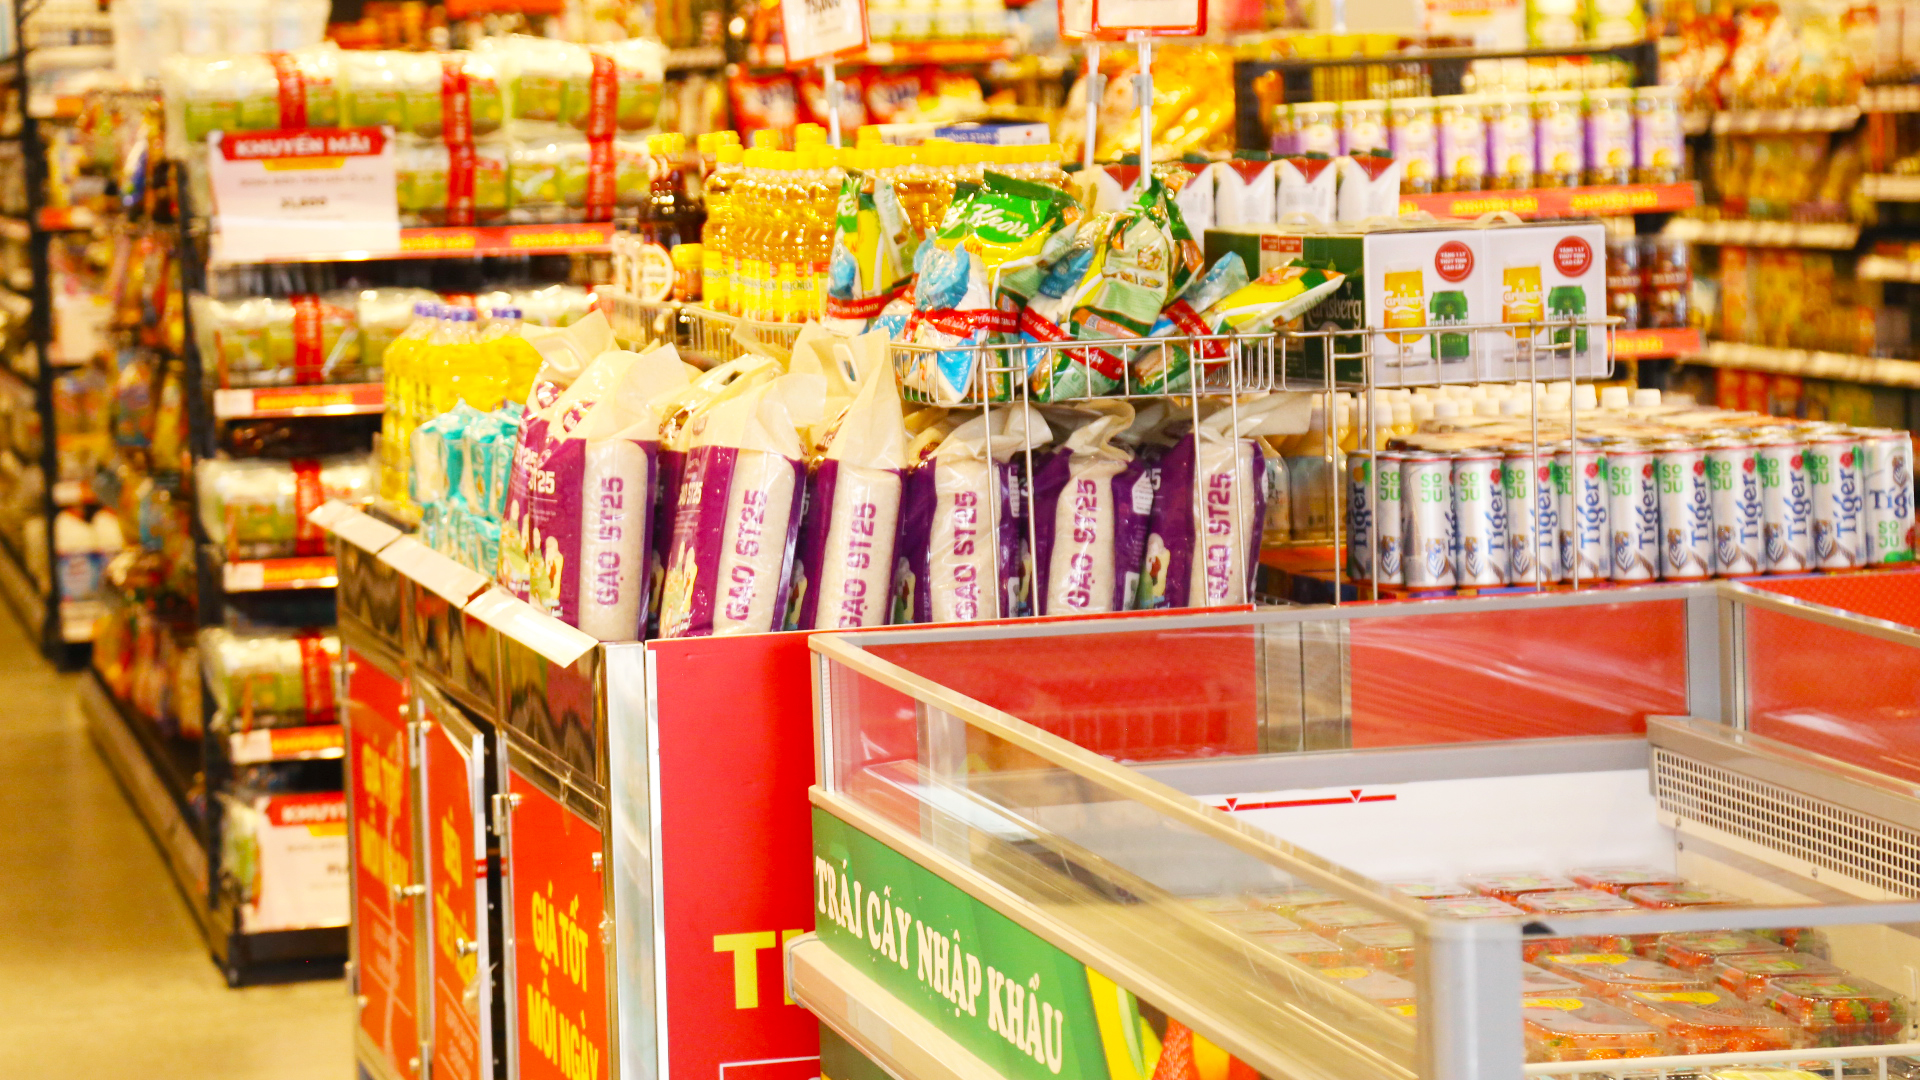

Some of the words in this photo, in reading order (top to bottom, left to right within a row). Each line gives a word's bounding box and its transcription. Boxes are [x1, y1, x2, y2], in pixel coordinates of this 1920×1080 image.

[968, 203, 1030, 238] Knorr
[598, 476, 624, 542] ST25
[735, 489, 768, 557] ST25
[846, 502, 877, 569] ST25
[953, 491, 978, 556] ST25
[1073, 478, 1098, 544] ST25
[1207, 472, 1232, 536] ST25
[1577, 478, 1607, 549] Tiger
[1635, 479, 1659, 550] Tiger
[1687, 476, 1712, 548] Tiger
[1735, 473, 1763, 544] Tiger
[1783, 470, 1812, 541] Tiger
[1832, 468, 1863, 538] Tiger
[1869, 486, 1913, 520] Tig
[1869, 486, 1913, 520] Tig
[596, 551, 625, 606] GẠO
[725, 565, 756, 621] GẠO
[838, 578, 869, 629] GẠO
[953, 564, 982, 620] GẠO
[1067, 552, 1096, 608] GẠO
[532, 880, 560, 968] GIÁ
[558, 894, 589, 993] TỐT
[815, 855, 863, 939] TRÁI
[916, 919, 983, 1018] NHẬP
[986, 972, 1063, 1075] KHẨU
[527, 957, 558, 1066] MỖI
[559, 1009, 599, 1080] NGÀY
